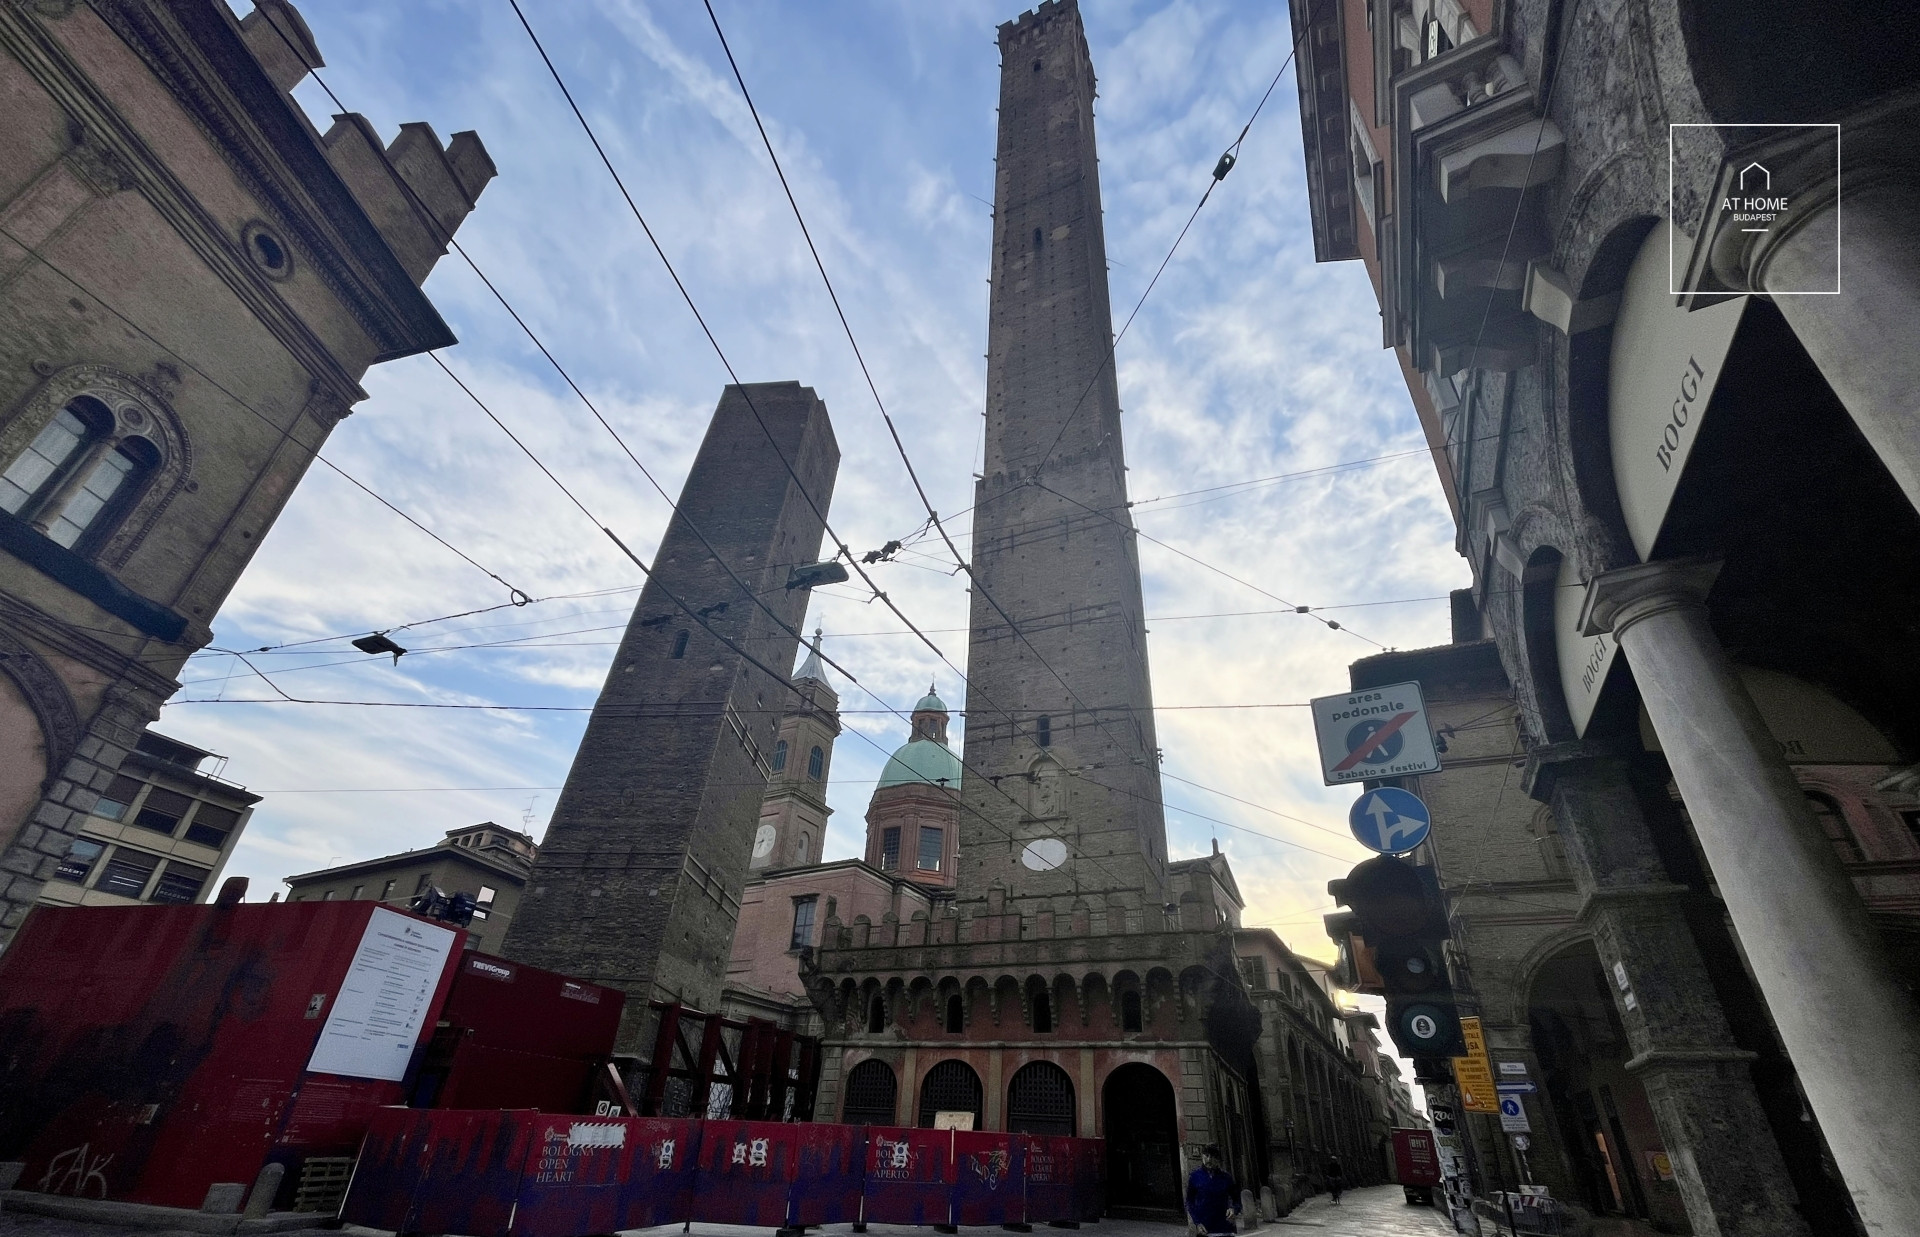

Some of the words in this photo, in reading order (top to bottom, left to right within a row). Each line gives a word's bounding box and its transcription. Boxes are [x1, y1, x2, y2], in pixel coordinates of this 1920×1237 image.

[1656, 354, 1705, 474] BOGGI
[1582, 634, 1607, 694] BOGGI
[1348, 692, 1382, 705] area
[1332, 701, 1405, 722] pedonale
[1337, 768, 1376, 780] Sabato
[1390, 761, 1427, 773] festivi
[472, 960, 511, 977] TREVIGroup
[1463, 1022, 1479, 1031] ZIONE
[541, 1146, 594, 1157] BOLOGNA
[538, 1158, 569, 1170] OPEN
[535, 1171, 574, 1183] HEART
[873, 1169, 910, 1179] APERTO
